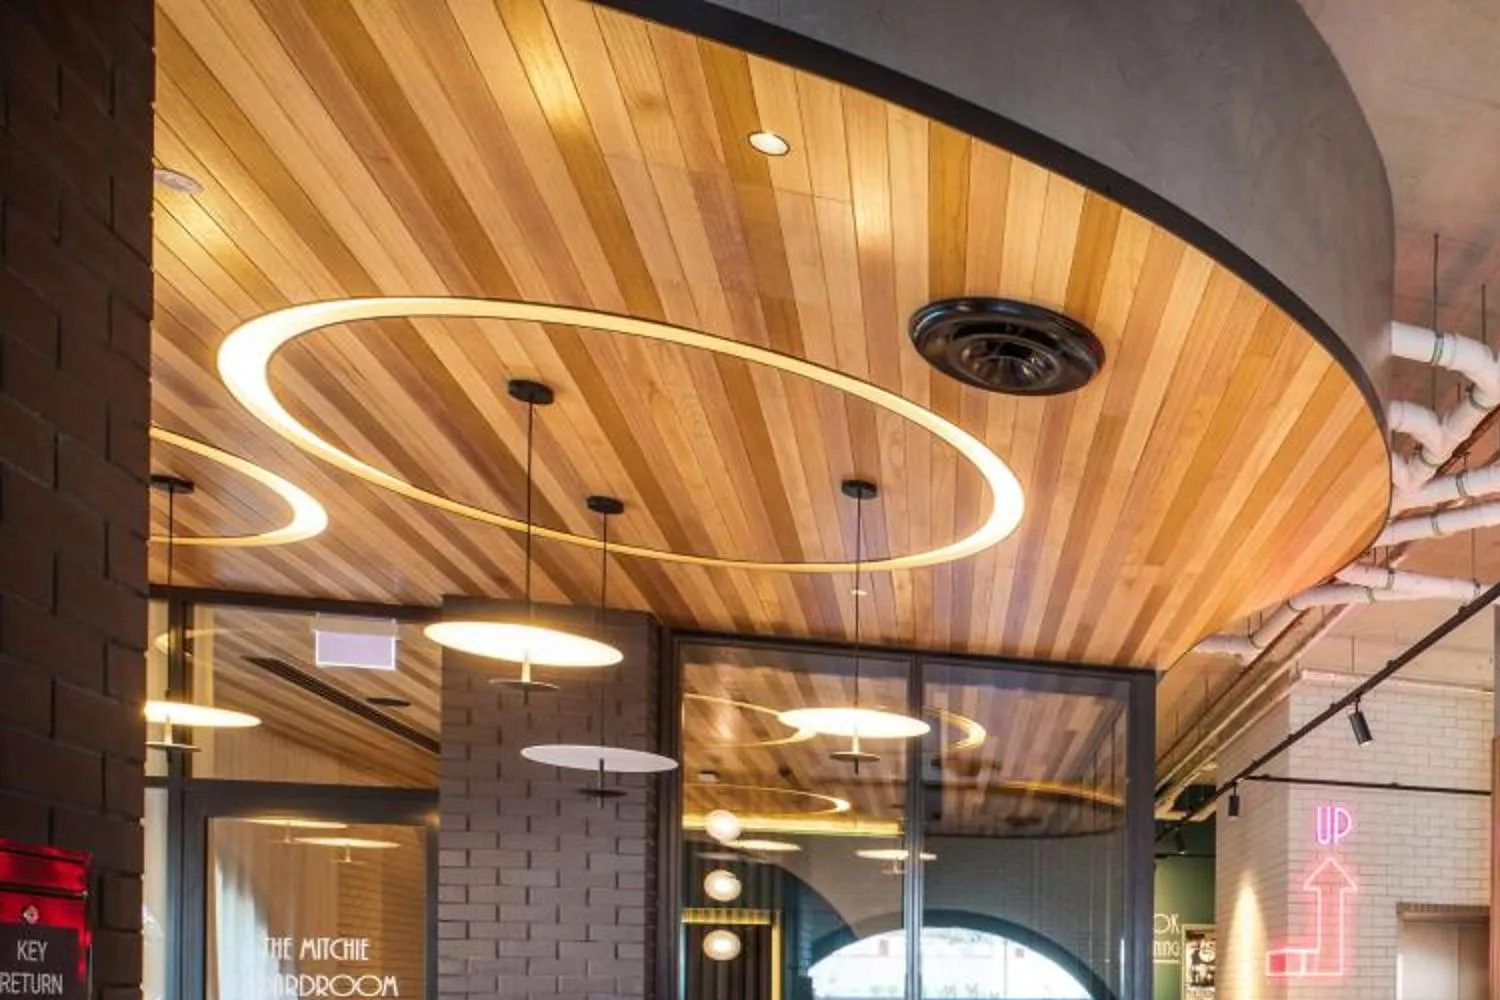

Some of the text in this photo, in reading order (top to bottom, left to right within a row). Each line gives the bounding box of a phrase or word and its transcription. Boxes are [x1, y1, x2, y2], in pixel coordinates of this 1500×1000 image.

[1317, 806, 1352, 845] UP
[16, 939, 48, 962] KEY
[264, 937, 370, 961] THE MITCHIE
[0, 972, 63, 996] RETURN
[266, 973, 399, 998] ARDROOM
